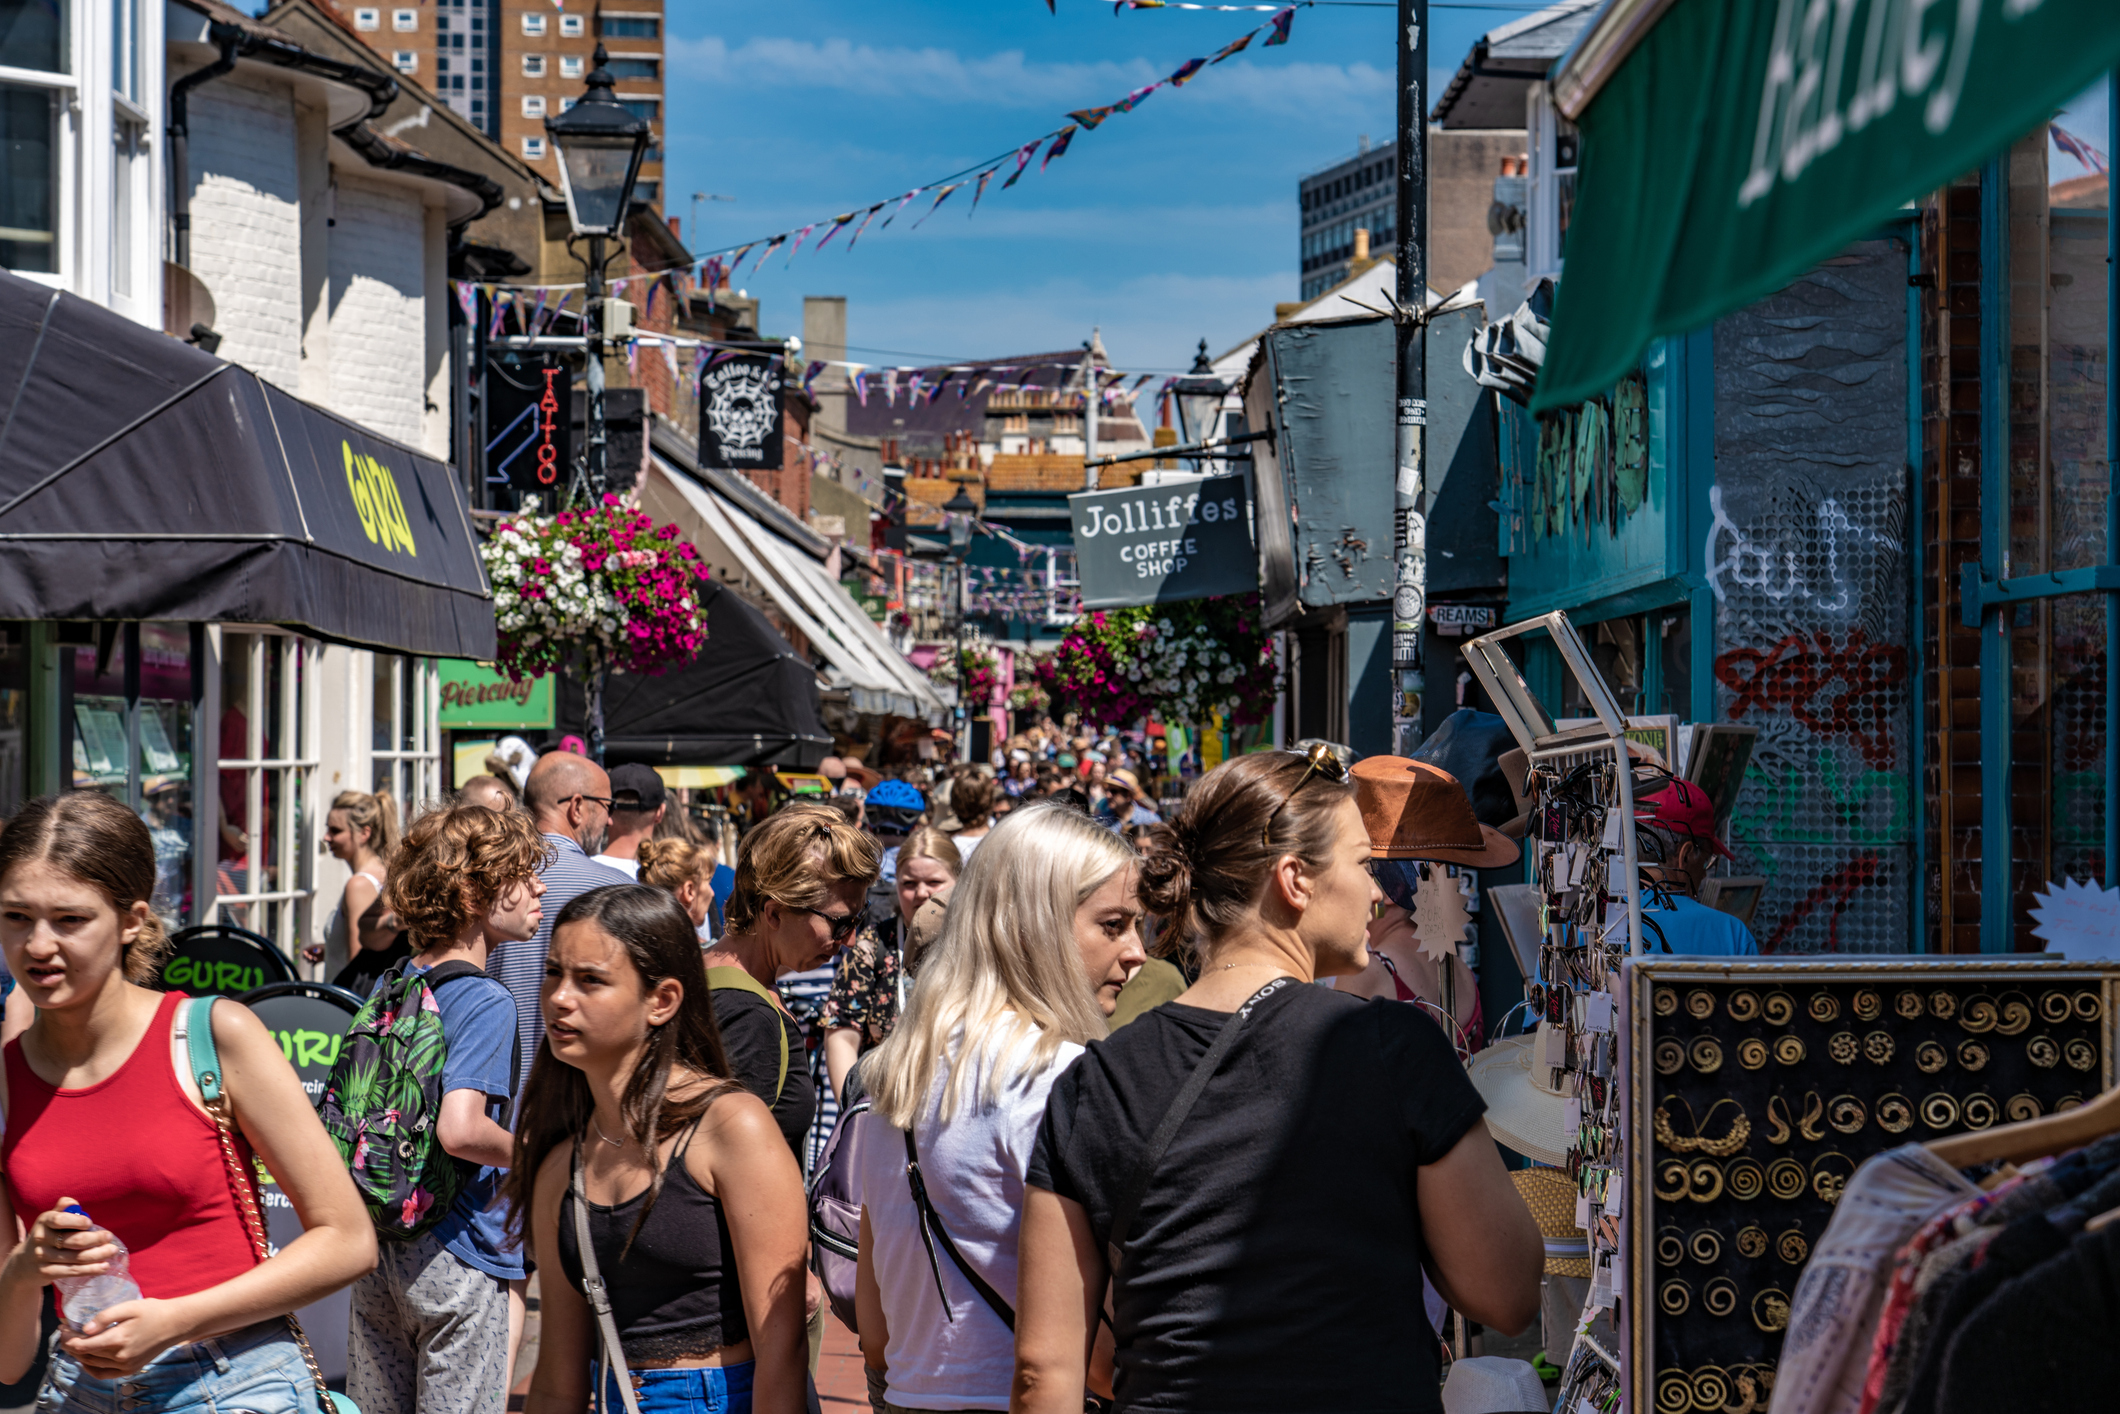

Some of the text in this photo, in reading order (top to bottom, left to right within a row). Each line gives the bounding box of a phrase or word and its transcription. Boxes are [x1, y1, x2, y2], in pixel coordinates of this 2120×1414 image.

[703, 362, 750, 389] Tattoo
[537, 368, 560, 484] TATTOO
[719, 444, 764, 462] Piercing
[1080, 493, 1238, 538] Jolliffes
[1120, 538, 1198, 563] COFFEE
[1136, 557, 1188, 579] SHOP
[441, 677, 535, 711] Piercing
[163, 956, 264, 993] GURU
[1239, 978, 1287, 1019] SONY
